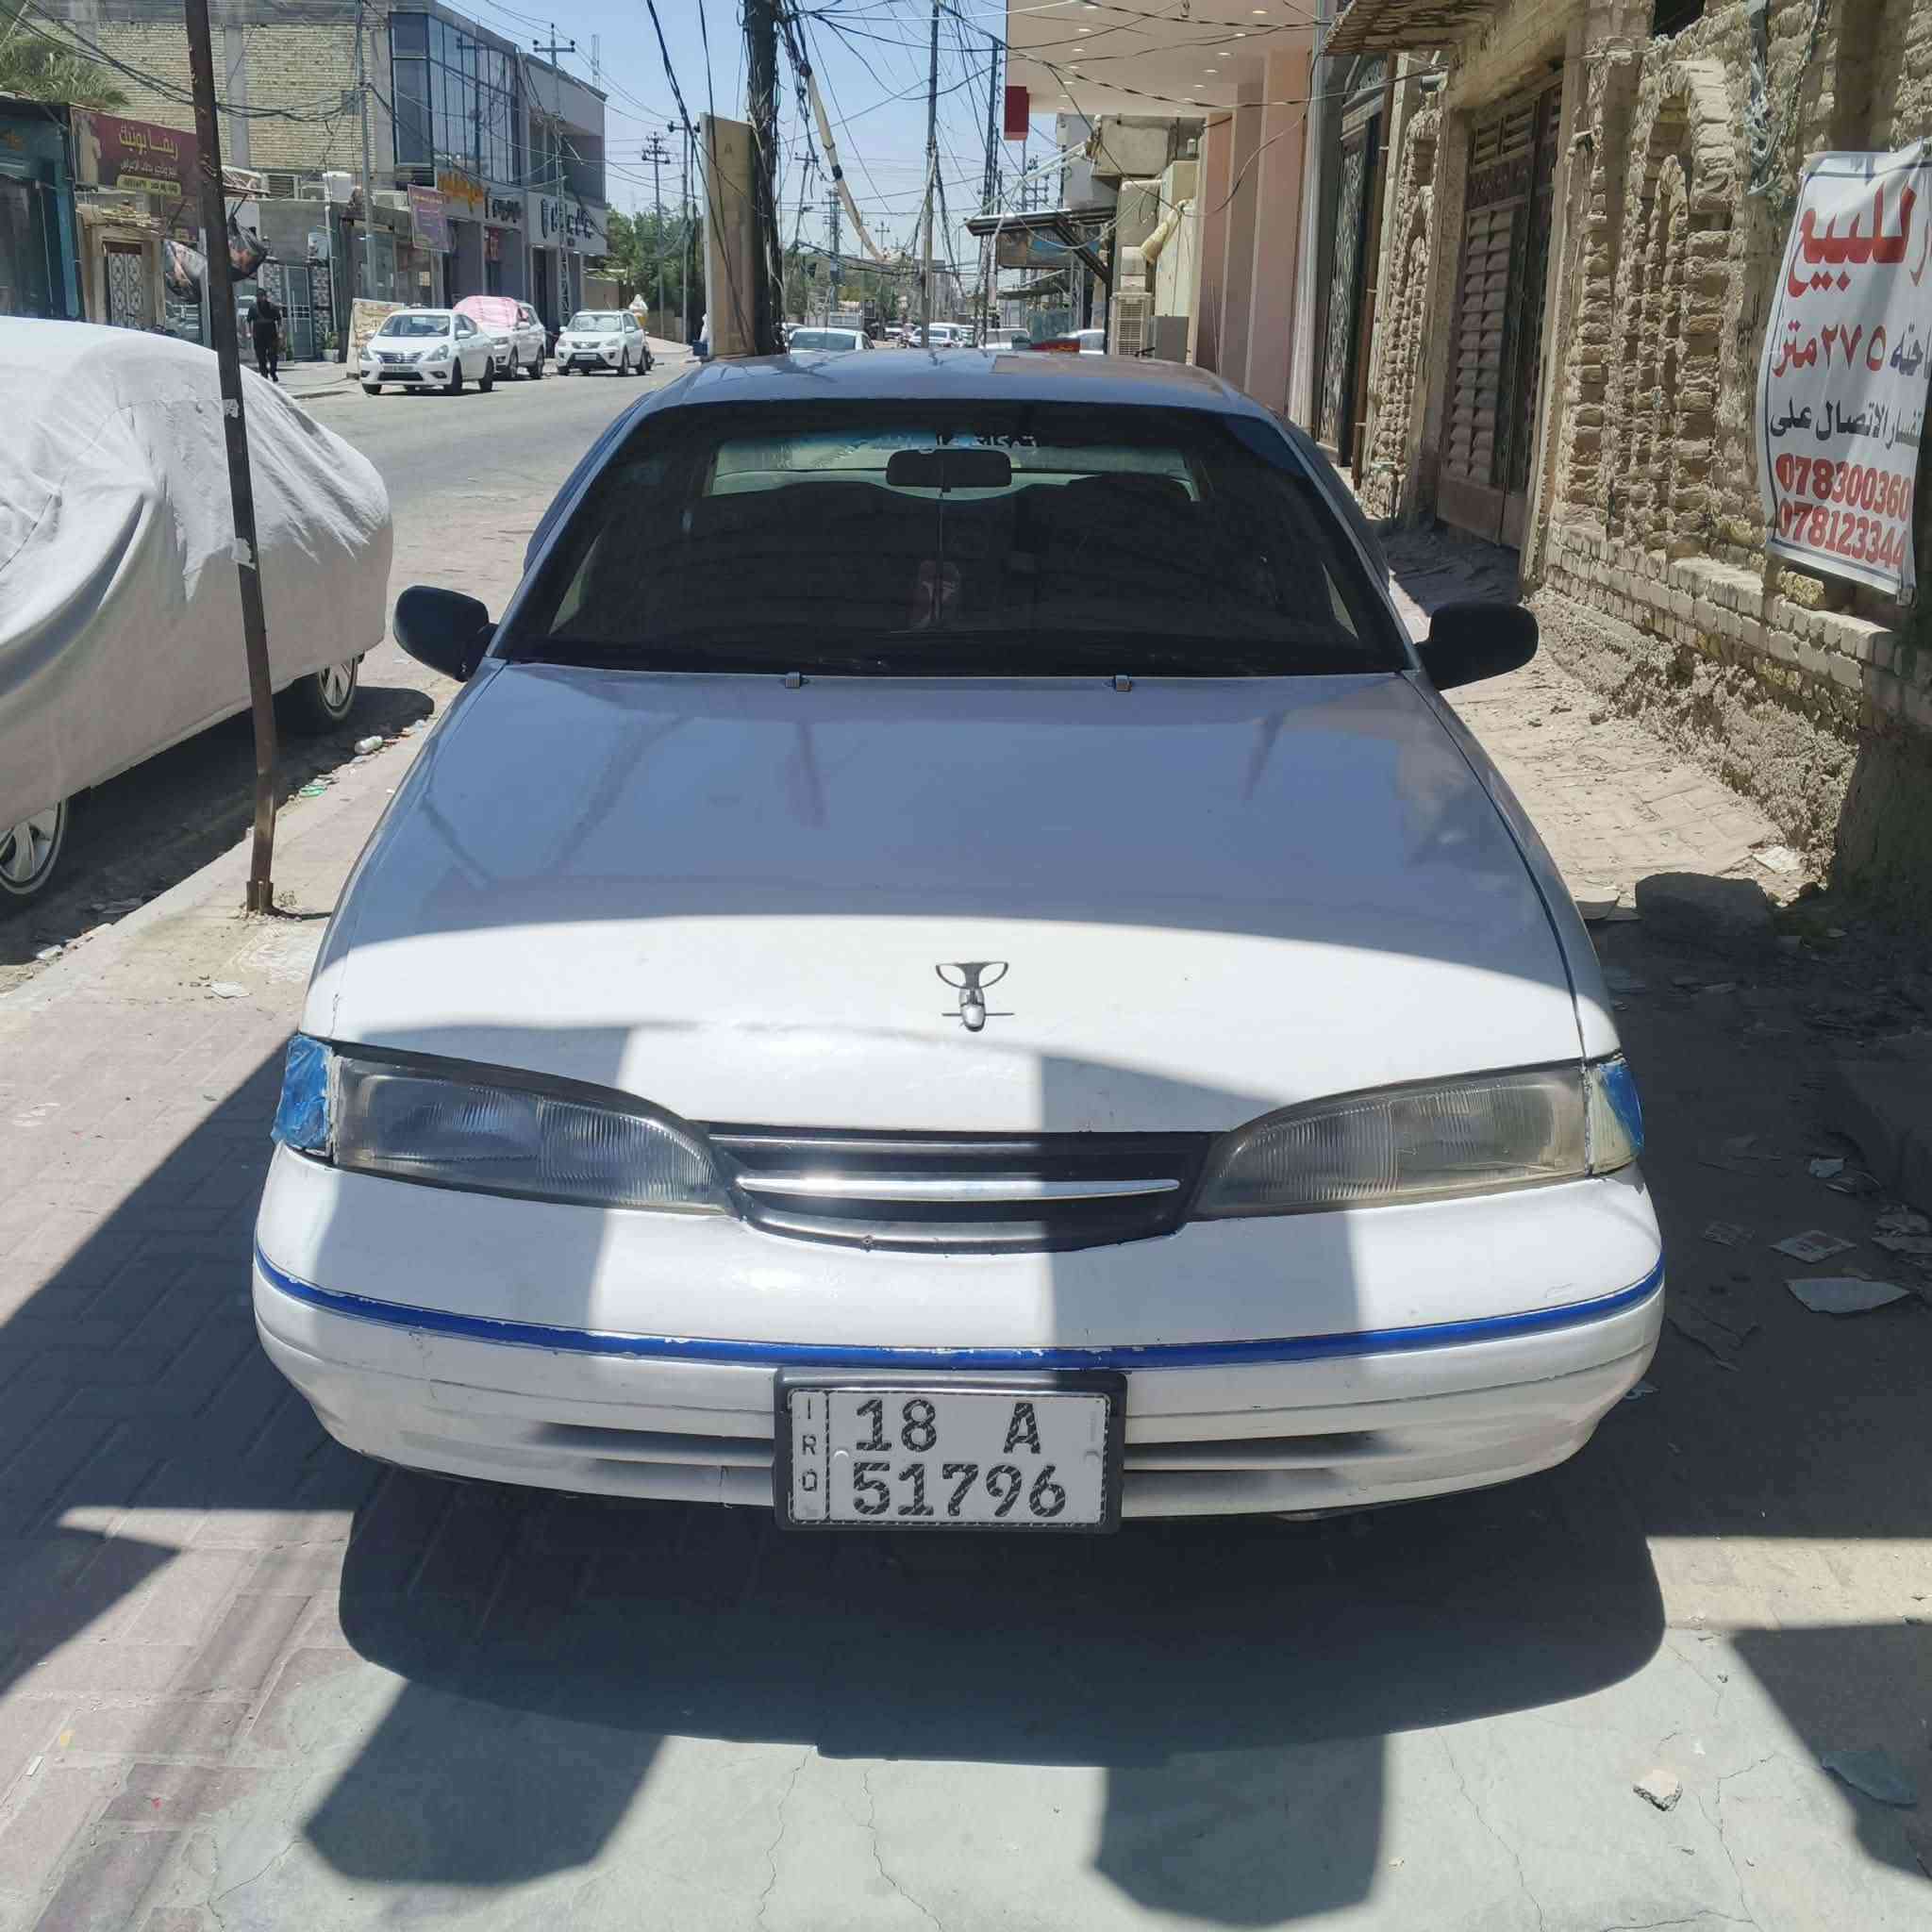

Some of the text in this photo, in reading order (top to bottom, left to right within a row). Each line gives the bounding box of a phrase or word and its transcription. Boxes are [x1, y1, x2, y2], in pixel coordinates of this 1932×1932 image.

[1788, 180, 1918, 298] للبيع
[1772, 319, 1817, 378] متر
[1770, 396, 1812, 437] على
[855, 1398, 1041, 1454] 18 A
[853, 1462, 1066, 1518] 51796
